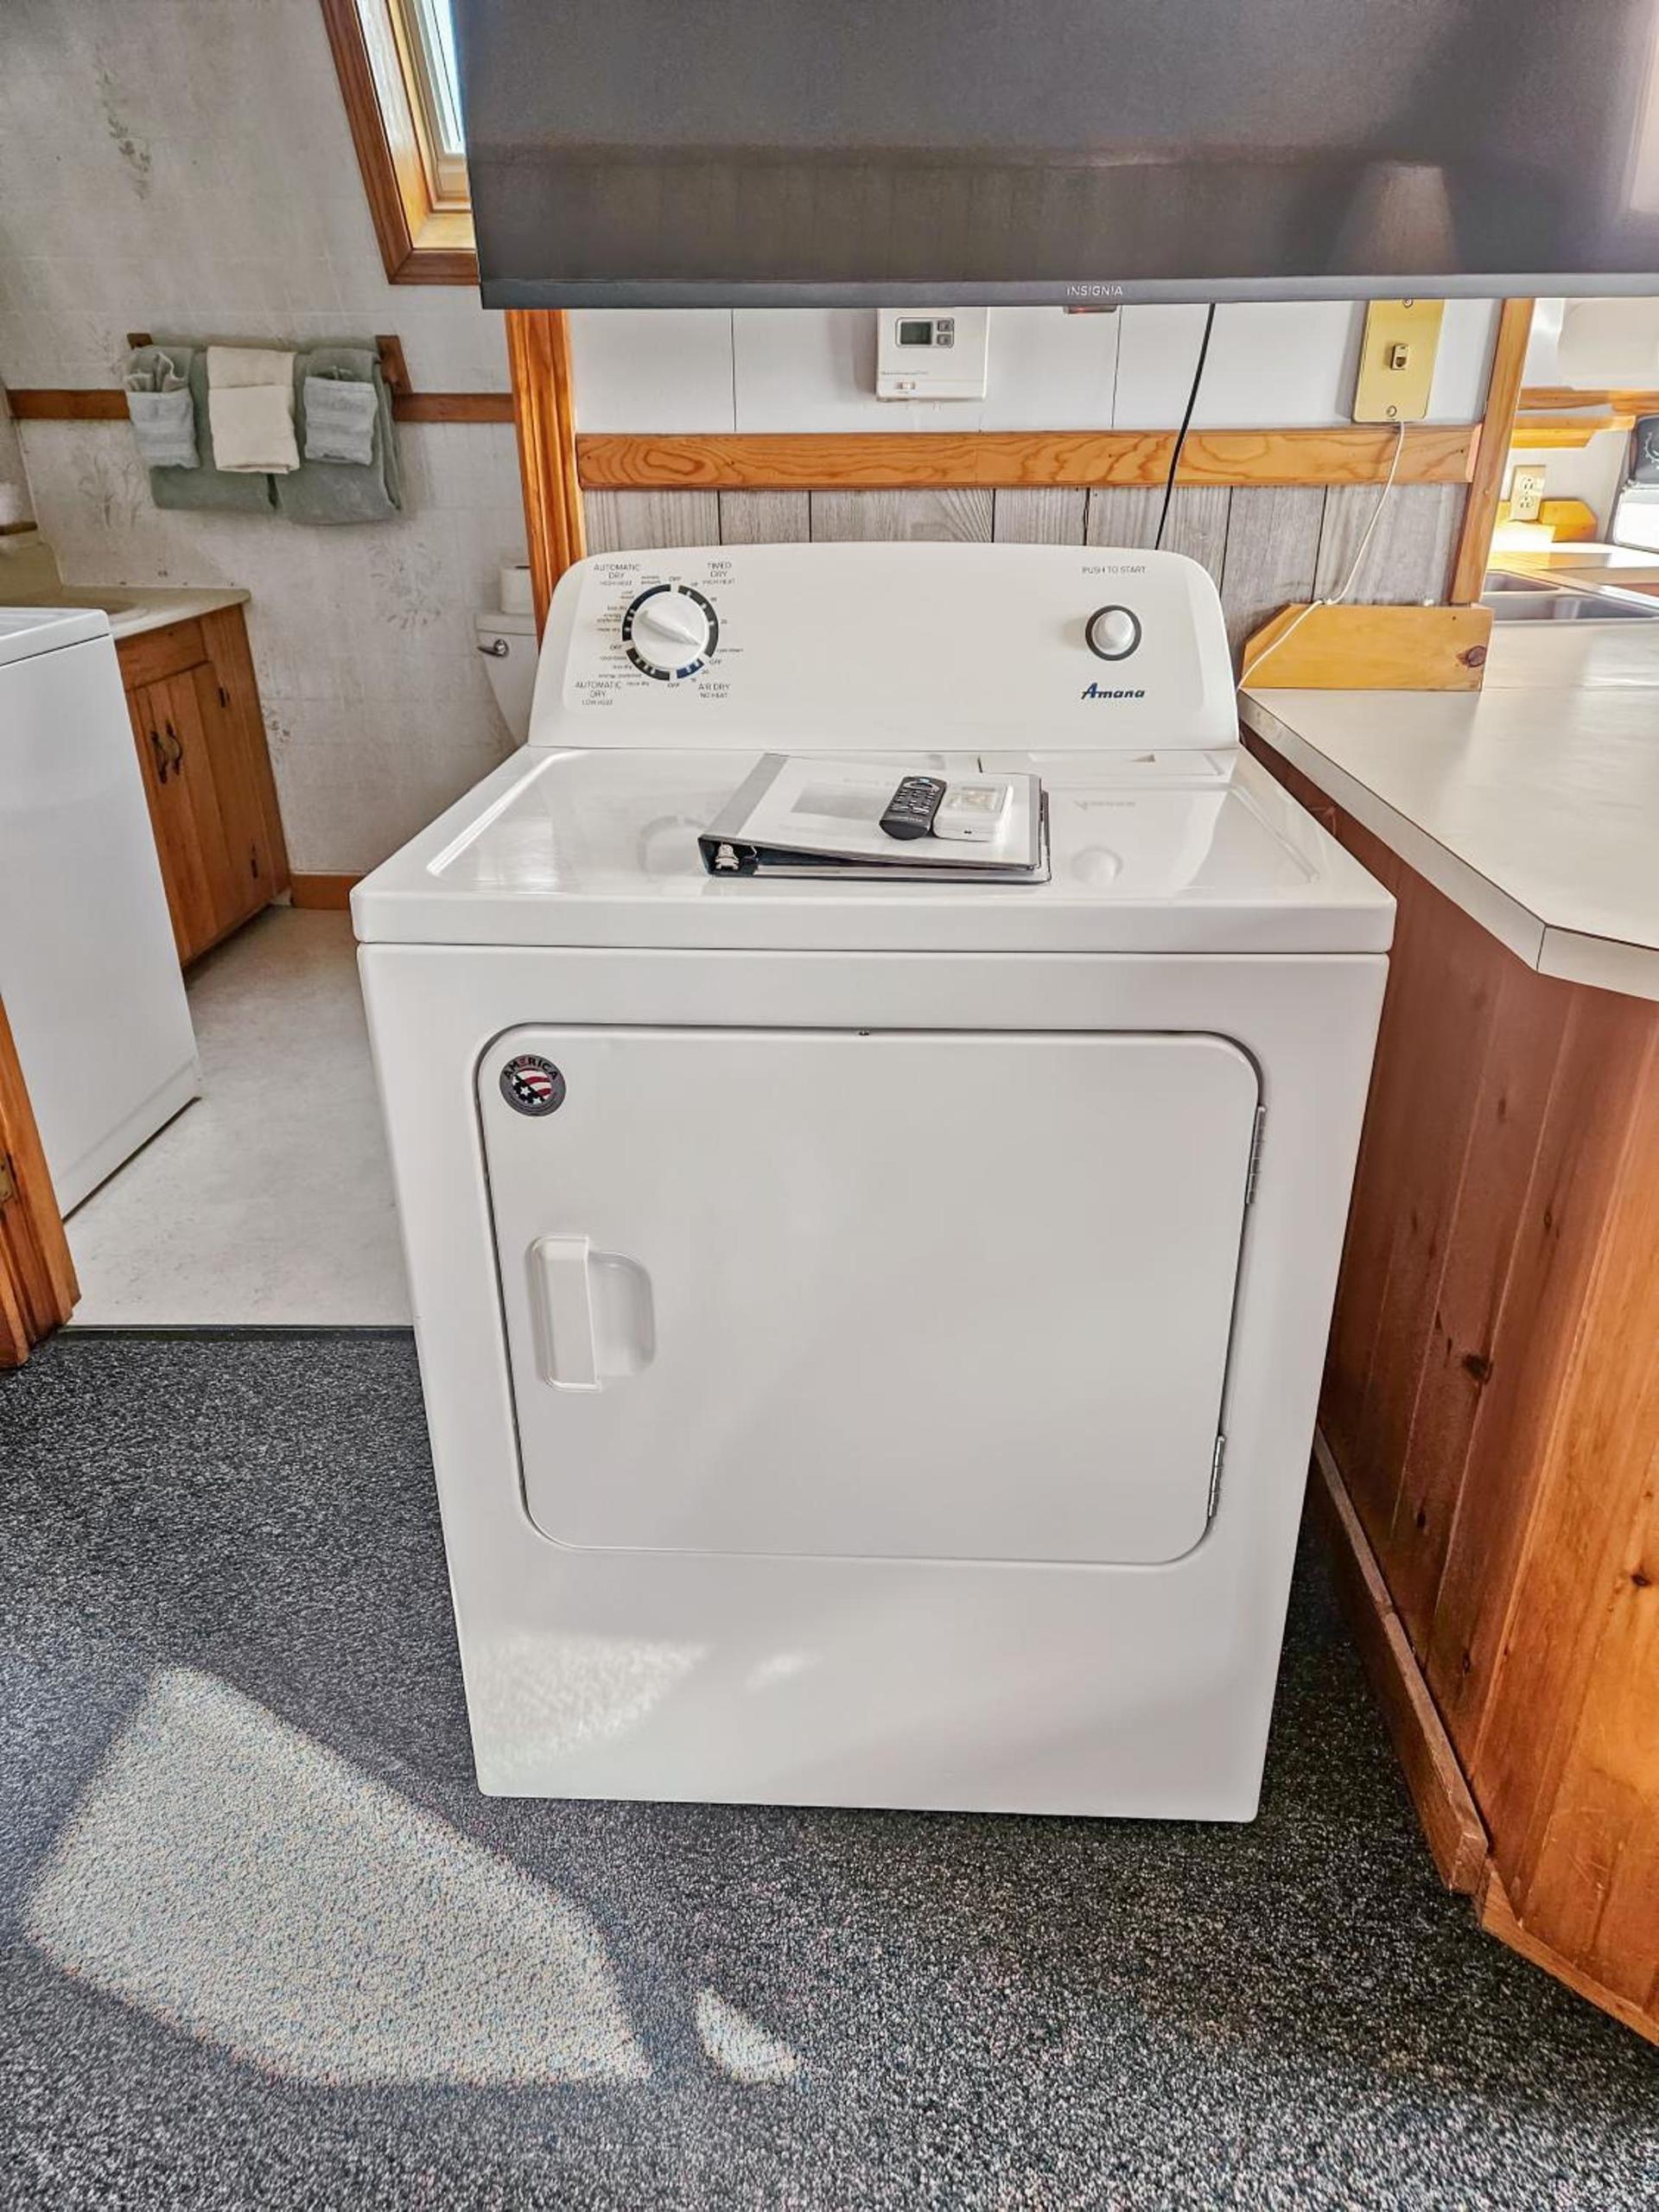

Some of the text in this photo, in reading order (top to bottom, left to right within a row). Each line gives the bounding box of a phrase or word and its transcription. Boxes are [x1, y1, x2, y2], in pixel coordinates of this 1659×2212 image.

[1066, 285, 1123, 296] INSIGNIA
[594, 563, 640, 572] AUTOMATIC
[1082, 565, 1146, 575] PUSH TO START
[575, 681, 622, 690] AUTOMATIC
[1081, 683, 1146, 699] Amana
[503, 1057, 558, 1080] AMERICA
